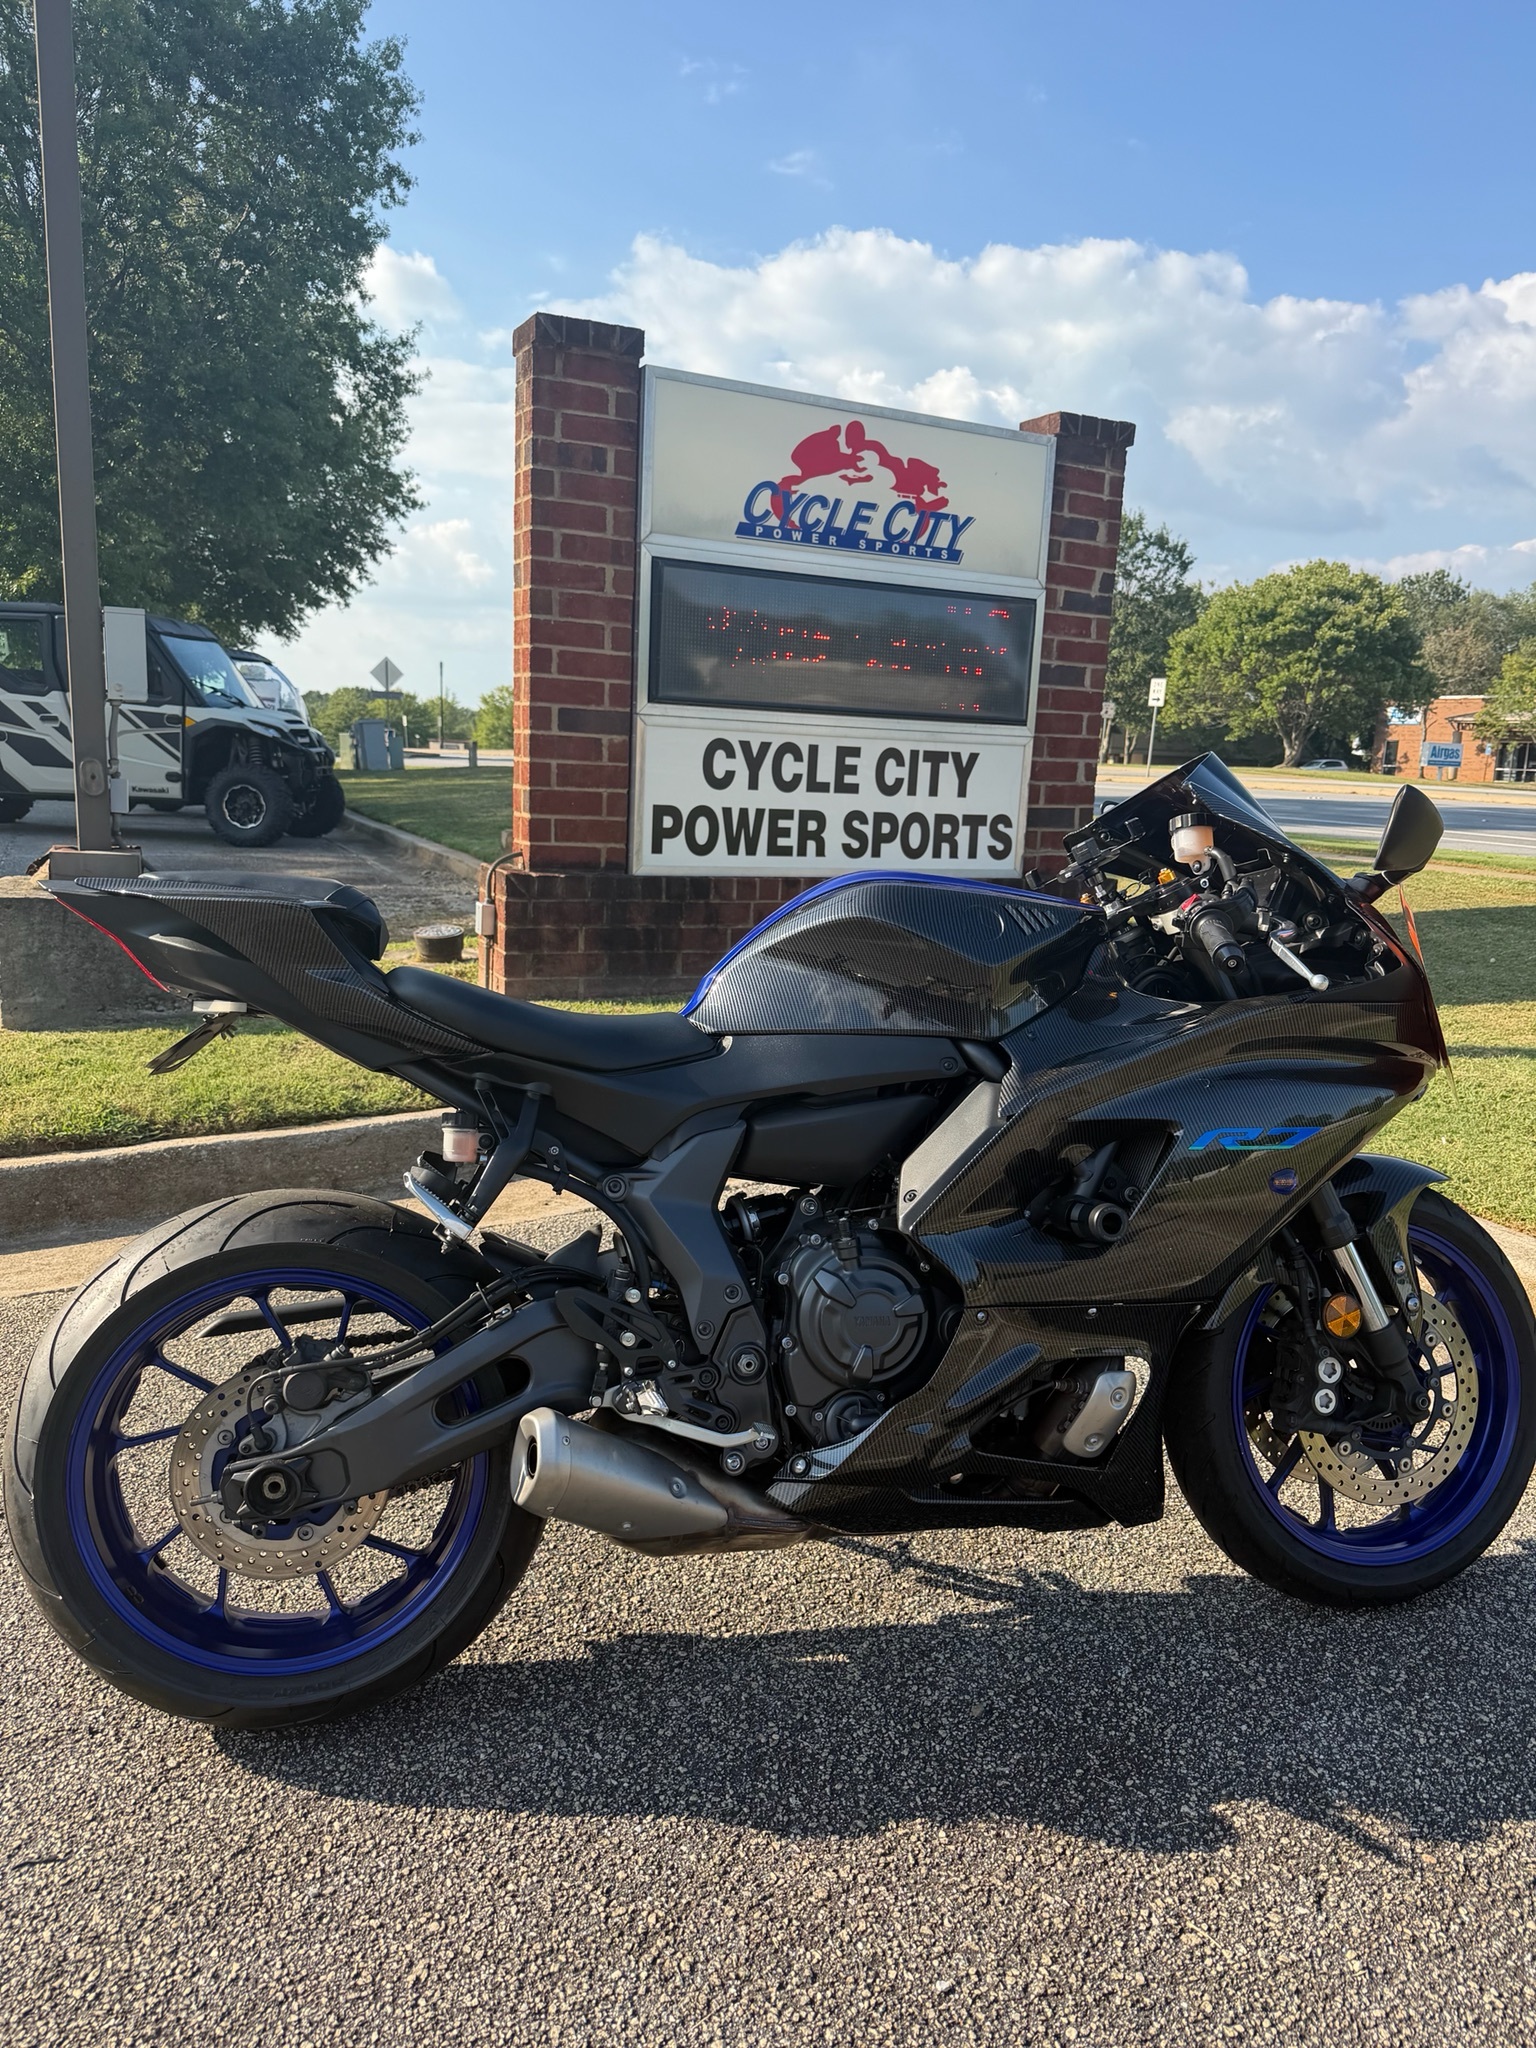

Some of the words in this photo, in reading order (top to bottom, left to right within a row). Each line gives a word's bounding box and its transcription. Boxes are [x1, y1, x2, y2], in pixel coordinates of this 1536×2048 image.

[743, 480, 880, 538] CYCLE
[882, 500, 977, 550] CITY
[755, 526, 837, 546] POWER
[858, 539, 949, 560] SPORTS
[702, 737, 862, 795] CYCLE
[875, 747, 981, 798] CITY
[1430, 745, 1460, 760] Airgas
[131, 786, 169, 794] Kawasaki
[650, 804, 827, 858] POWER
[841, 809, 1014, 861] SPORTS
[853, 1315, 891, 1327] YAMAHA
